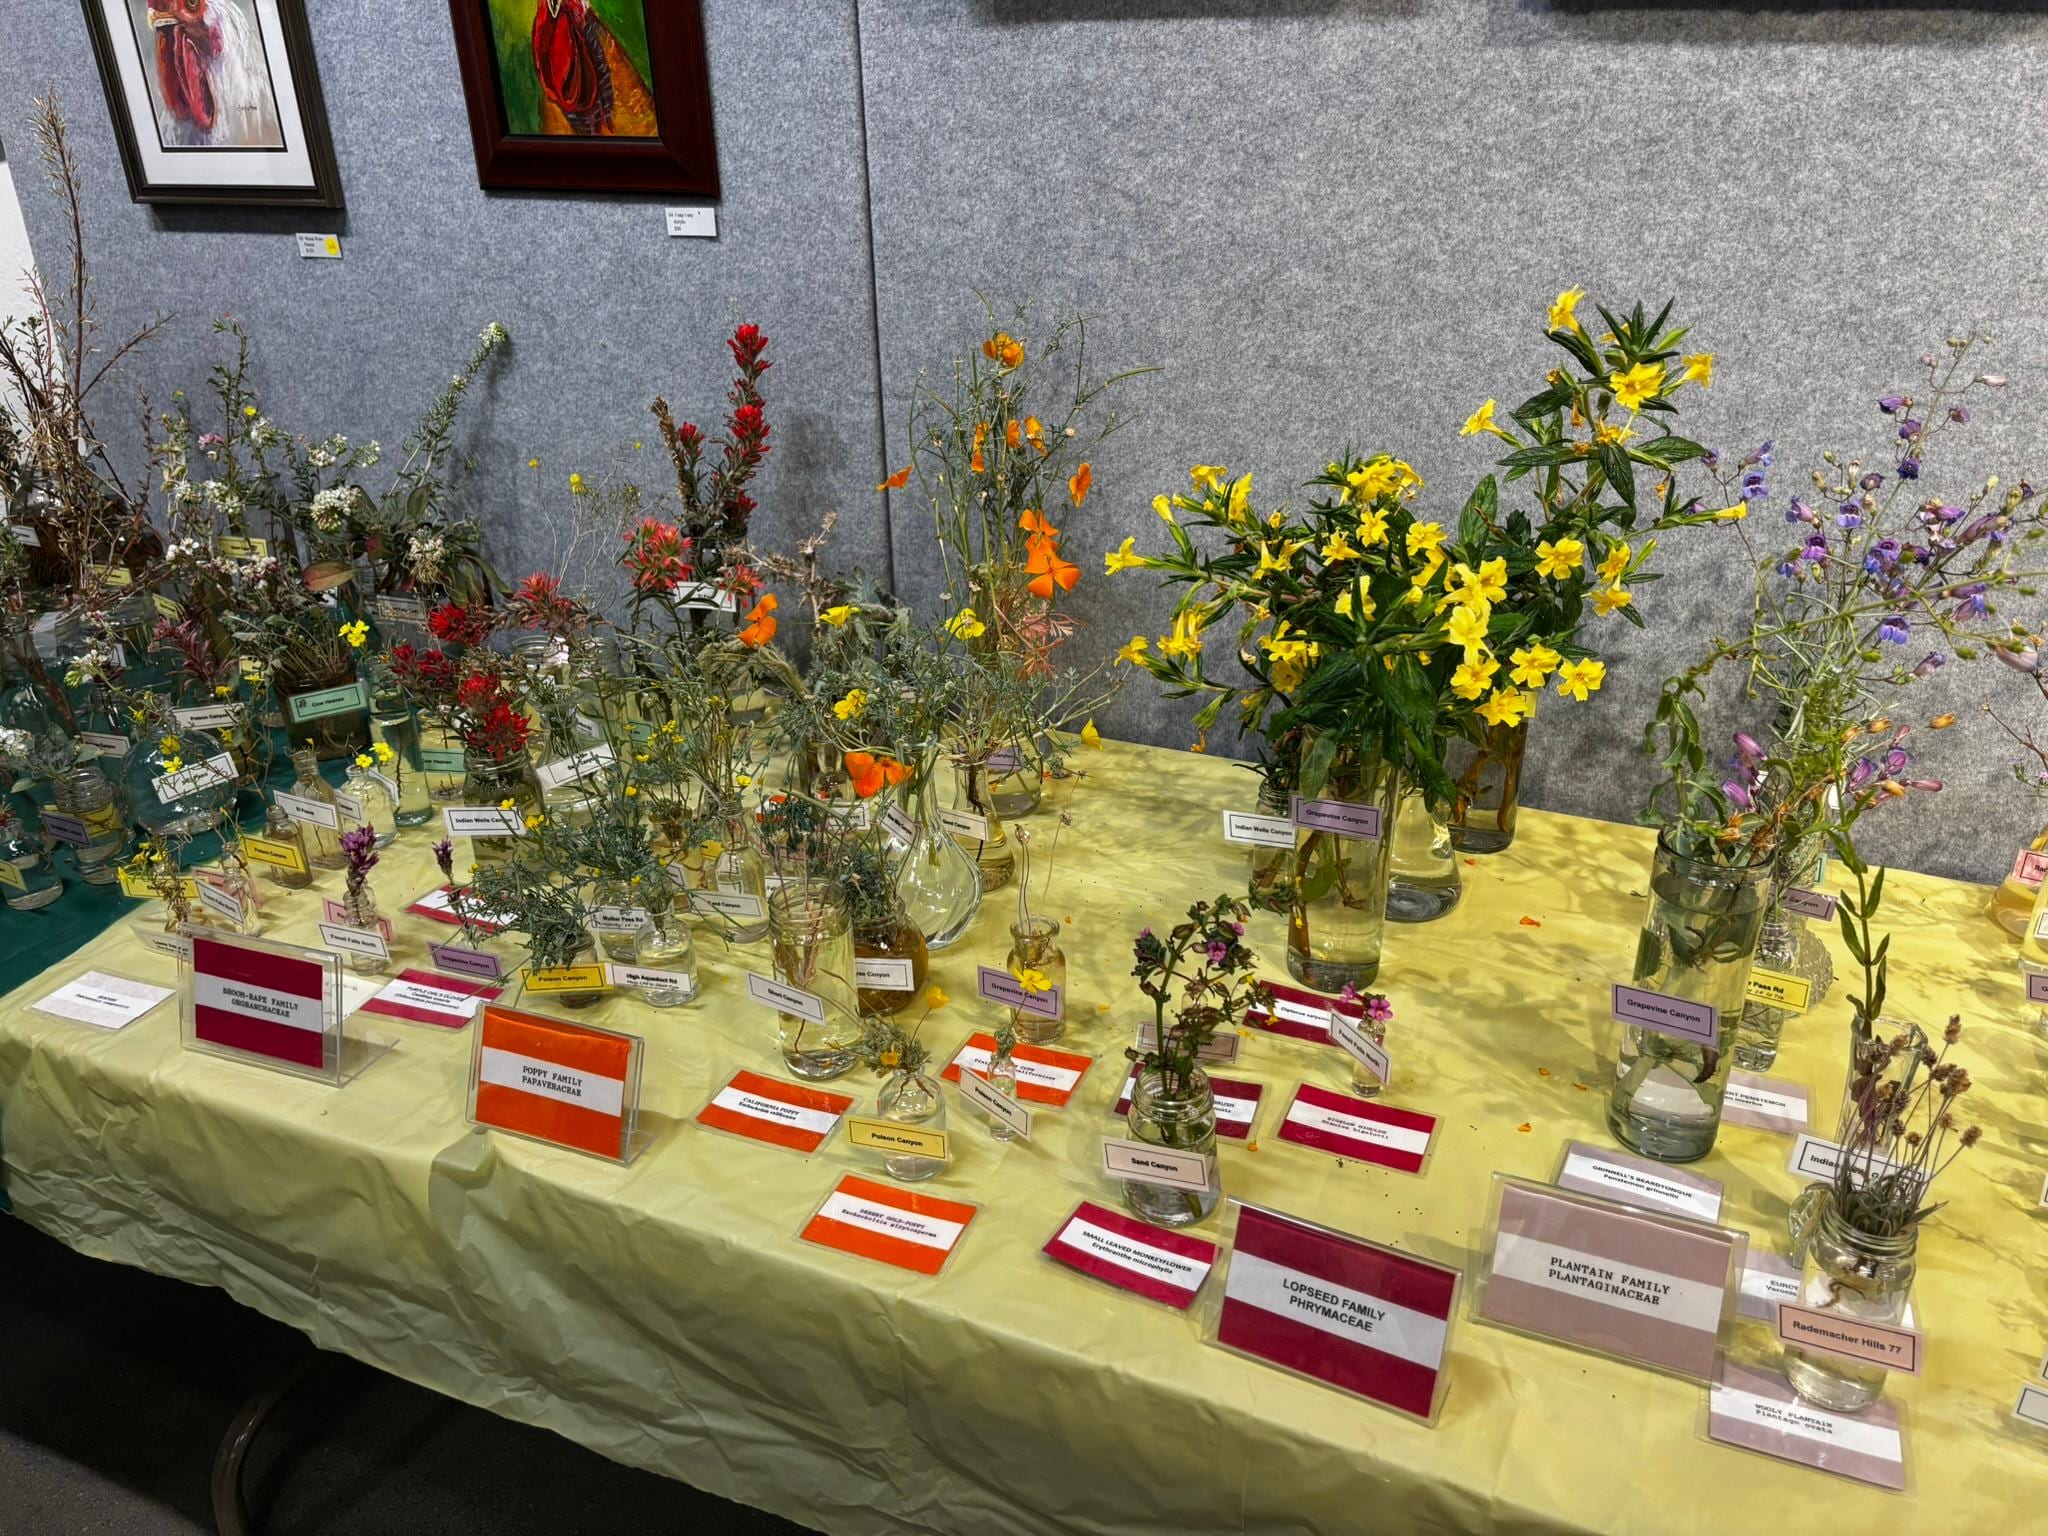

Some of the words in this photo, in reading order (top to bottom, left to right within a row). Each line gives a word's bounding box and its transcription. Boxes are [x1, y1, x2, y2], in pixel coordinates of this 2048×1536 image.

[324, 697, 345, 706] Heaven
[455, 817, 472, 825] Indian
[473, 817, 490, 825] Wells
[942, 818, 954, 826] Sand
[955, 821, 971, 831] Canyon
[1306, 808, 1341, 822] Grapevine
[1342, 815, 1368, 826] Canyon
[1235, 823, 1253, 831] Indian
[1254, 826, 1269, 834] Wells
[1270, 828, 1293, 837] Canyon
[270, 851, 287, 860] Canyon
[330, 933, 346, 942] Fossil
[347, 936, 360, 945] Falls
[361, 939, 377, 949] North
[441, 954, 468, 966] Grapevine
[468, 959, 490, 970] Canyon
[538, 975, 561, 983] Poison
[562, 974, 587, 984] Canyon
[641, 974, 668, 983] Aqueduct
[866, 970, 890, 979] Canyon
[768, 988, 783, 999] Short
[783, 992, 803, 1006] Canyon
[991, 981, 1023, 997] Grapevine
[1025, 989, 1049, 1004] Canyon
[1753, 981, 1771, 991] Pass
[1773, 985, 1784, 994] Rd
[222, 987, 267, 1006] BROOM-RAPE
[271, 997, 299, 1012] FAMILY
[231, 998, 291, 1018] OROBANCHACEAE
[1627, 998, 1668, 1015] Grapevine
[1669, 1006, 1701, 1023] Canyon
[1339, 1029, 1353, 1048] Fossil
[1354, 1043, 1365, 1056] Falls
[1365, 1052, 1380, 1068] North
[522, 1065, 548, 1079] POPPY
[552, 1072, 583, 1088] FAMILY
[522, 1075, 582, 1097] PAPAVERACEAE
[743, 1097, 779, 1110] CALIFORNIA
[780, 1107, 800, 1116] POPPY
[974, 1086, 993, 1103] Poison
[992, 1099, 1012, 1116] Canyon
[1740, 1093, 1786, 1108] PENSTEMON
[871, 1132, 895, 1142] Poison
[897, 1135, 923, 1148] Canyon
[1131, 1156, 1150, 1168] Sand
[1150, 1160, 1178, 1173] Canyon
[1810, 1154, 1840, 1169] Indian
[1592, 1165, 1635, 1180] GRINNELL'S
[1635, 1177, 1693, 1198] BEARDTONGUE
[1603, 1173, 1645, 1189] Penstemon
[860, 1208, 884, 1218] DESERT
[886, 1215, 926, 1230] GOLD-POPPY
[1082, 1230, 1104, 1243] SMALL
[1105, 1239, 1132, 1253] LEAVED
[1132, 1249, 1192, 1273] MONKEYFLOWER
[1091, 1241, 1132, 1261] Erythranthe
[1132, 1257, 1173, 1275] microphylla
[1550, 1256, 1613, 1281] PLANTAIN
[1620, 1273, 1671, 1296] FAMILY
[1548, 1268, 1660, 1306] PLANTAGINACEAE
[1283, 1278, 1340, 1309] LOPSEED
[1341, 1297, 1387, 1322] FAMILY
[1289, 1295, 1373, 1333] PHRYMACEAE
[1792, 1320, 1860, 1344] Rademacher
[1861, 1337, 1886, 1351] Hills
[1888, 1343, 1902, 1354] 77
[1755, 1403, 1782, 1416] WOOLY
[1788, 1412, 1833, 1429] PLANTAIN
[1755, 1409, 1800, 1426] Plantago
[1804, 1423, 1833, 1434] ovata
